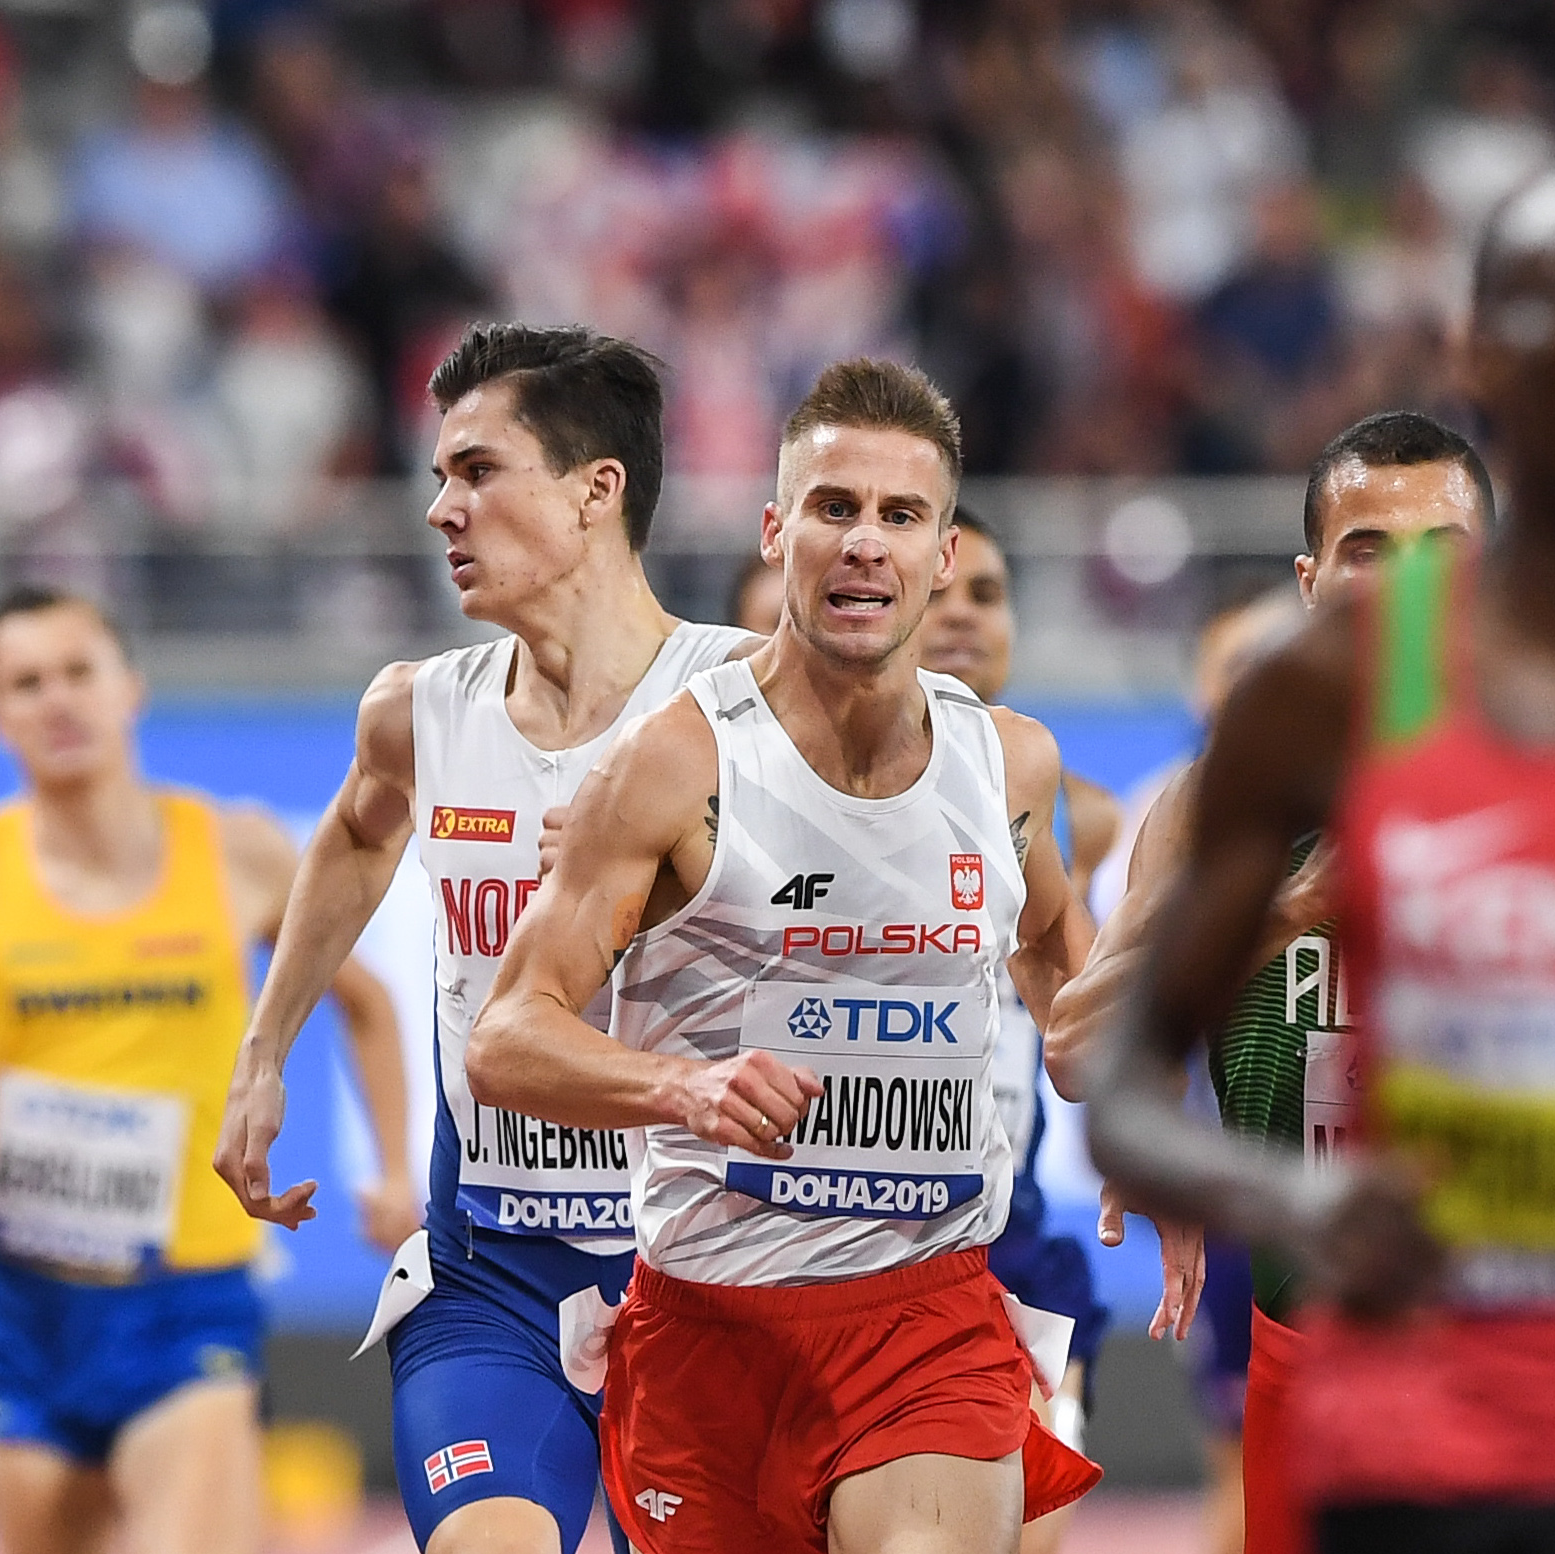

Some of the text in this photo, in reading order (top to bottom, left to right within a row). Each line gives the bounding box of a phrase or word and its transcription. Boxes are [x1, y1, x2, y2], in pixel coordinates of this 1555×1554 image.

[458, 816, 510, 834] EXTRA
[771, 873, 835, 910] 4F
[782, 924, 981, 957] POLSKA
[833, 998, 960, 1043] TDK
[466, 1100, 489, 1163] J.
[770, 1171, 949, 1213] DOHA2019
[498, 1193, 634, 1229] DOHA20
[635, 1488, 683, 1522] 4F
